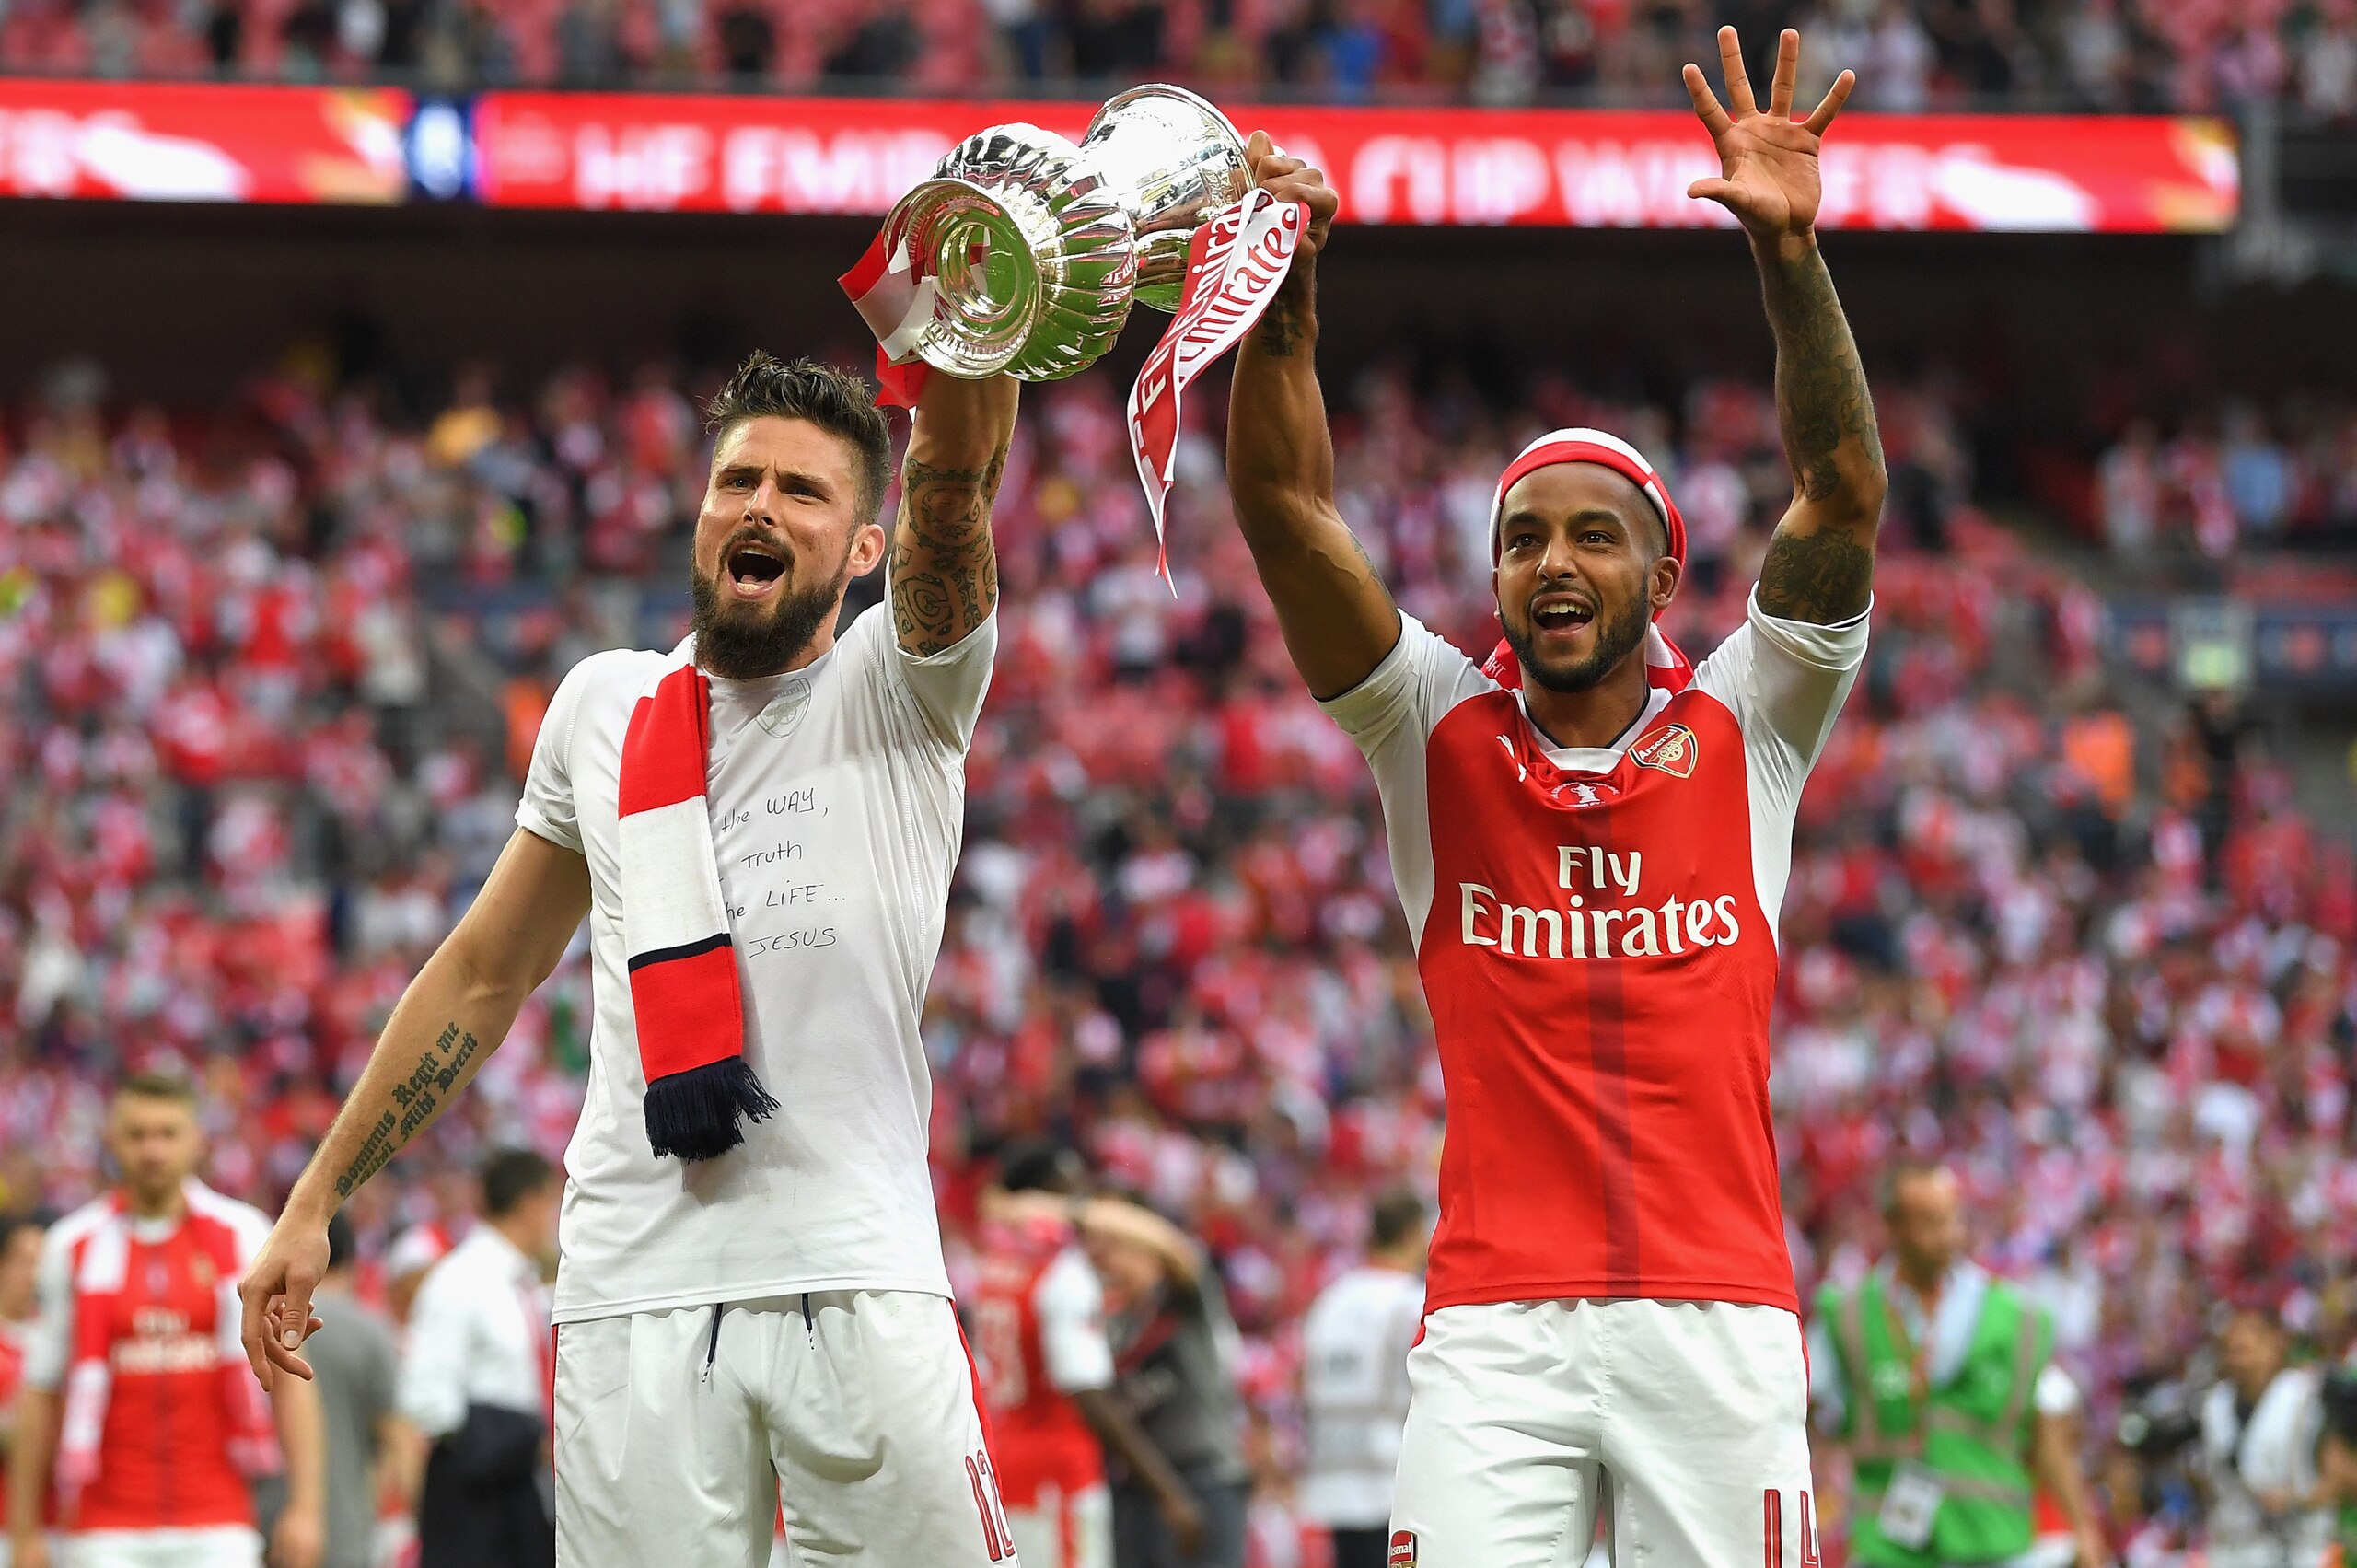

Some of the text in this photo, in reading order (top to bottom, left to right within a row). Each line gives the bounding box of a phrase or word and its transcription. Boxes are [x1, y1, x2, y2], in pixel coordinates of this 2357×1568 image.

[1637, 728, 1678, 761] Arsenal
[721, 808, 749, 833] the
[1556, 845, 1643, 897] Fly
[1457, 881, 1741, 960] Emirates
[749, 927, 837, 958] JESUS
[436, 1021, 459, 1053] me
